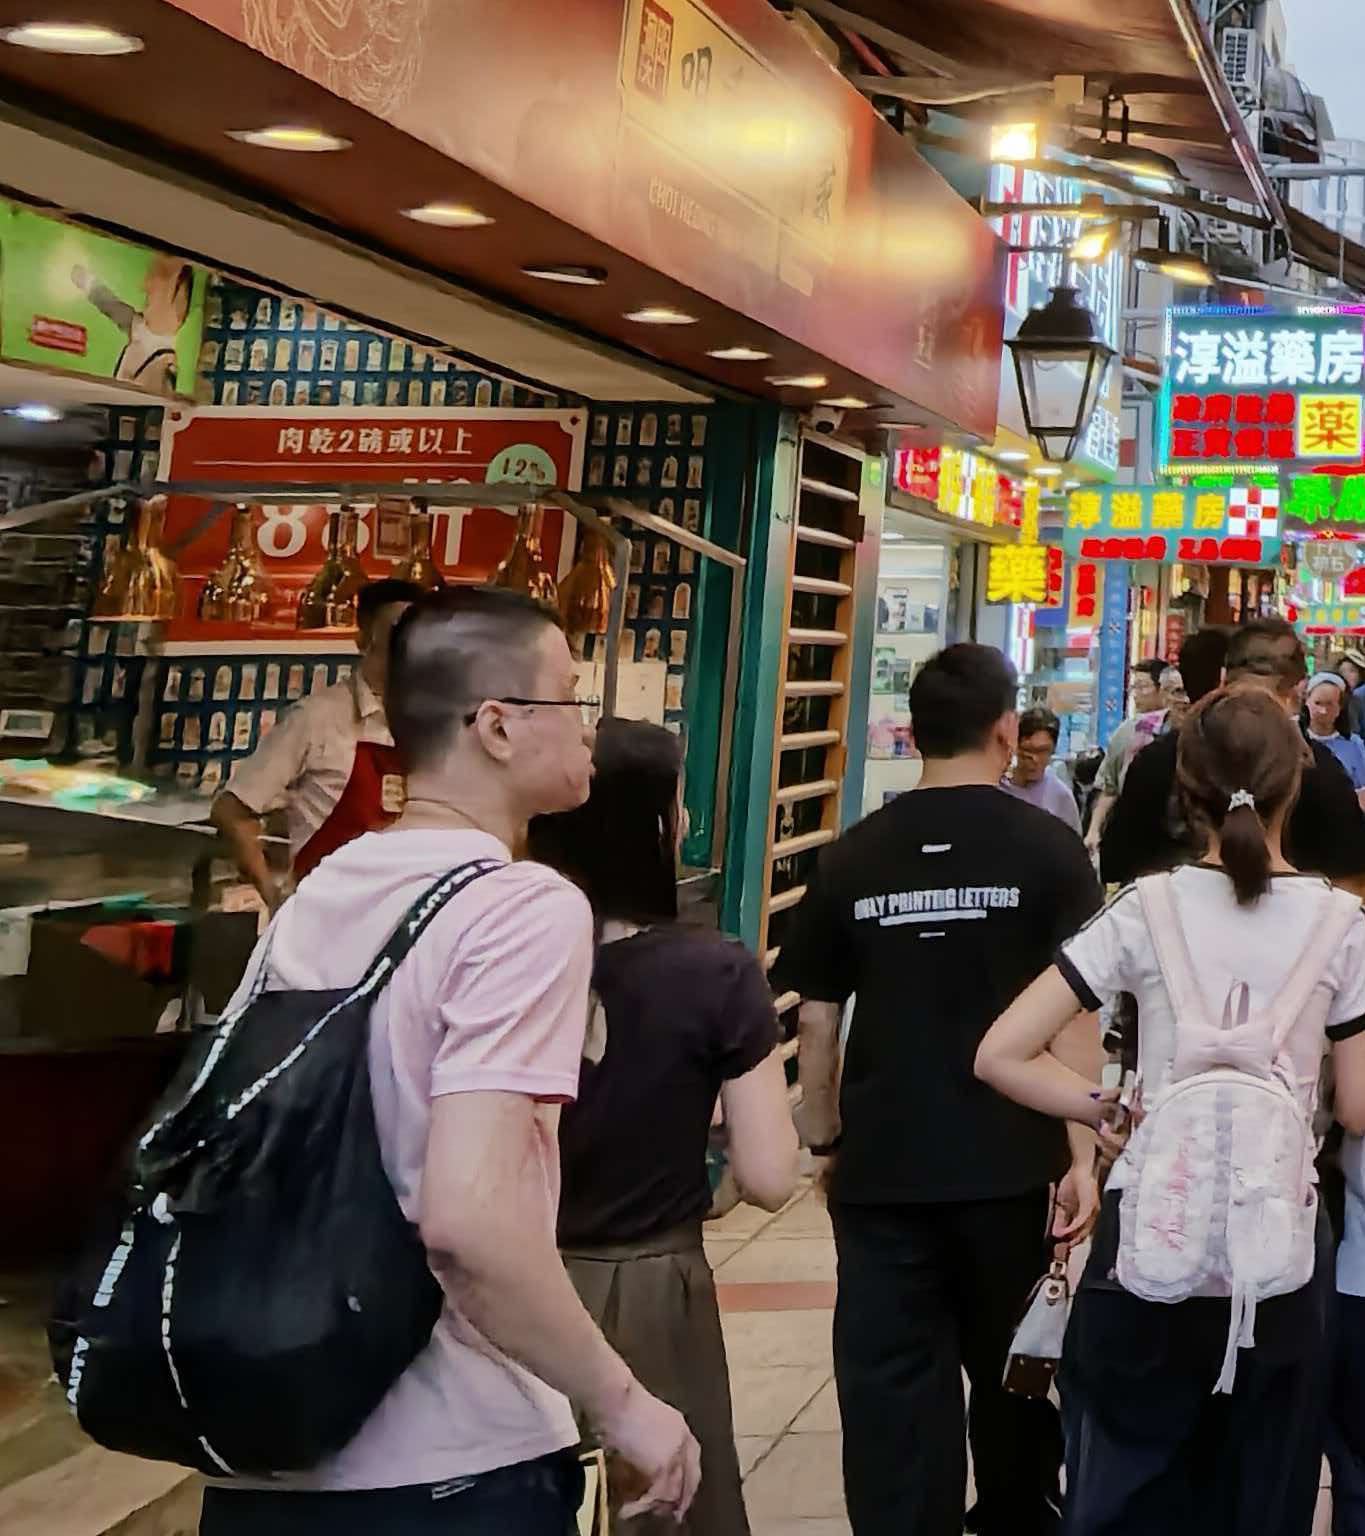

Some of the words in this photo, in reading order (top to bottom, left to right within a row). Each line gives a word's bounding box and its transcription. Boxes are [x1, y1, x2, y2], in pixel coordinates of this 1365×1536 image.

[1174, 328, 1365, 385] 淳溢藥房
[958, 886, 1021, 908] LETTERS
